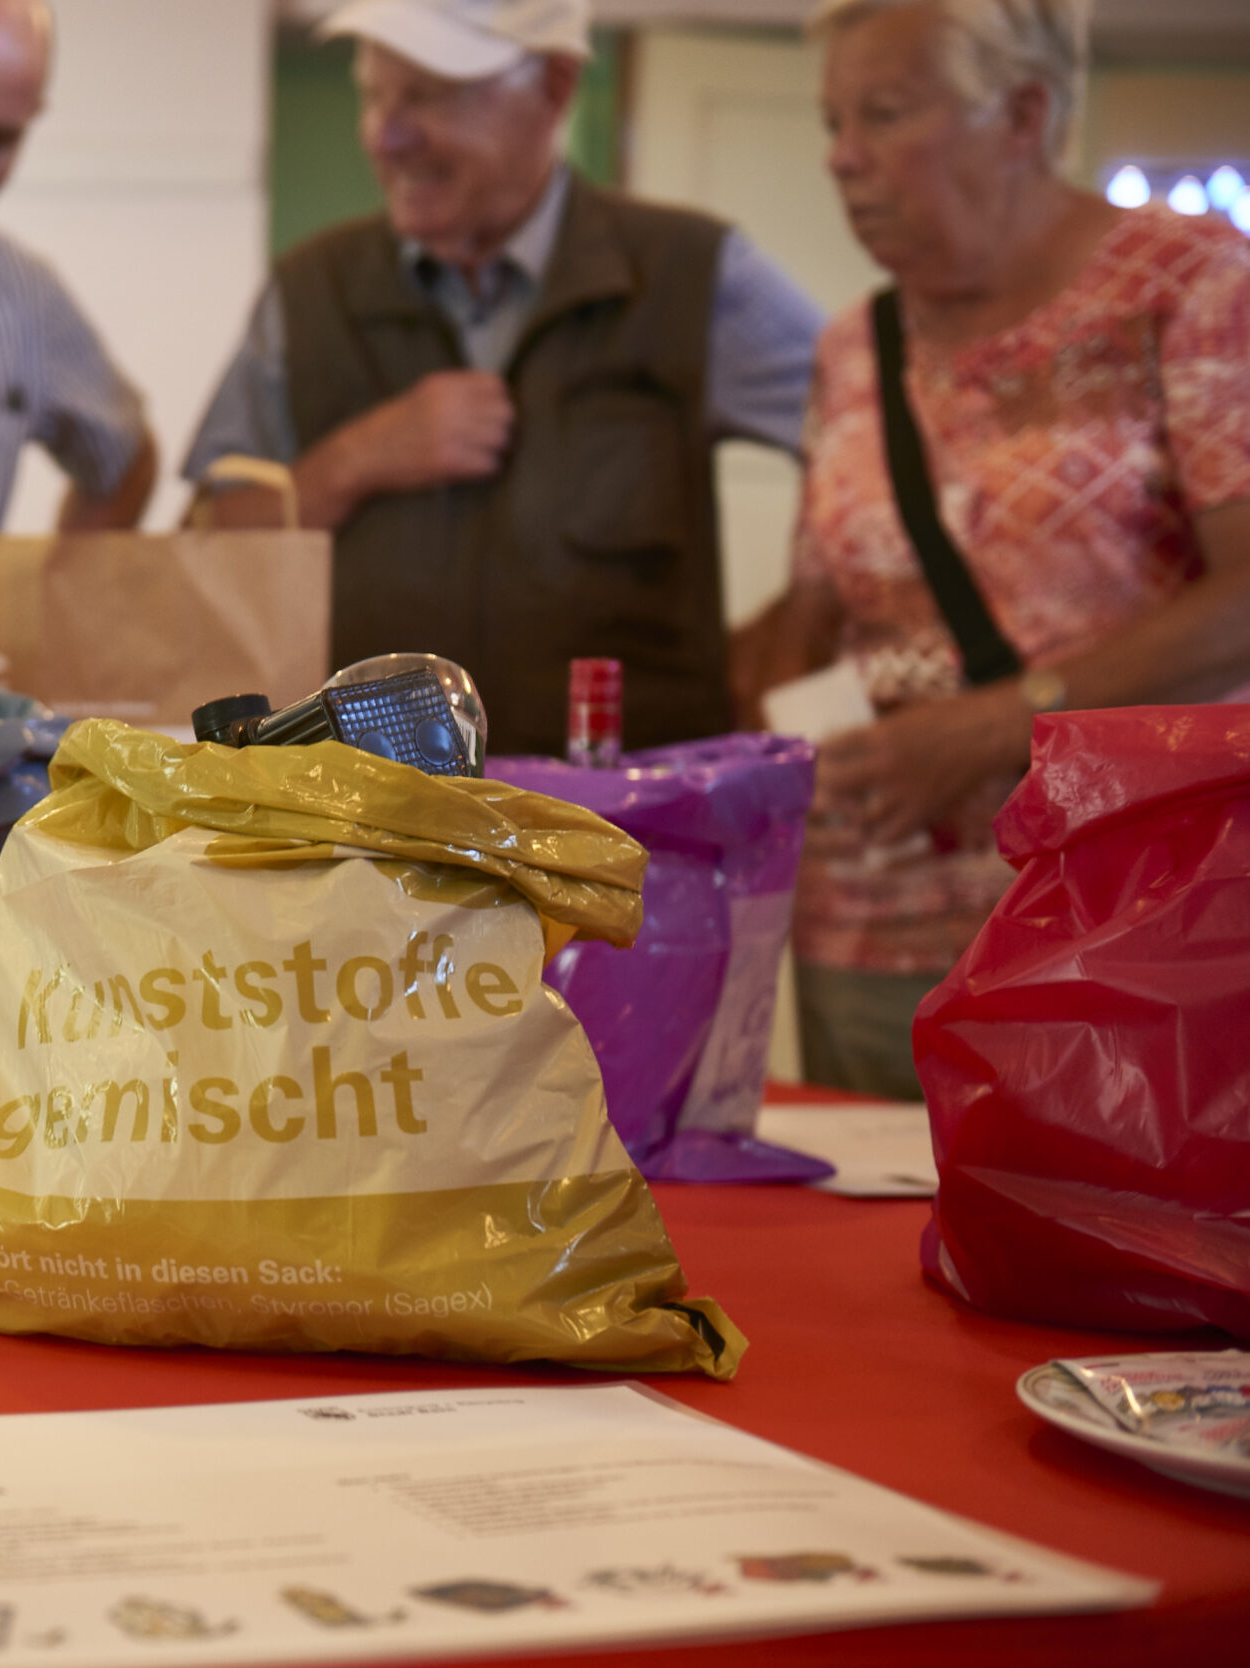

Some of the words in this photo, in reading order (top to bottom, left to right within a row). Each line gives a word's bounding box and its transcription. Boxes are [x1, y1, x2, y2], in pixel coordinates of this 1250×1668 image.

[18, 931, 524, 1049] Kunststoffe
[39, 1252, 108, 1280] nicht
[115, 1257, 143, 1282] in
[152, 1258, 249, 1284] diesen
[258, 1259, 343, 1285] Sack:
[251, 1294, 373, 1320] Styropor
[385, 1280, 493, 1319] (Sagex)
